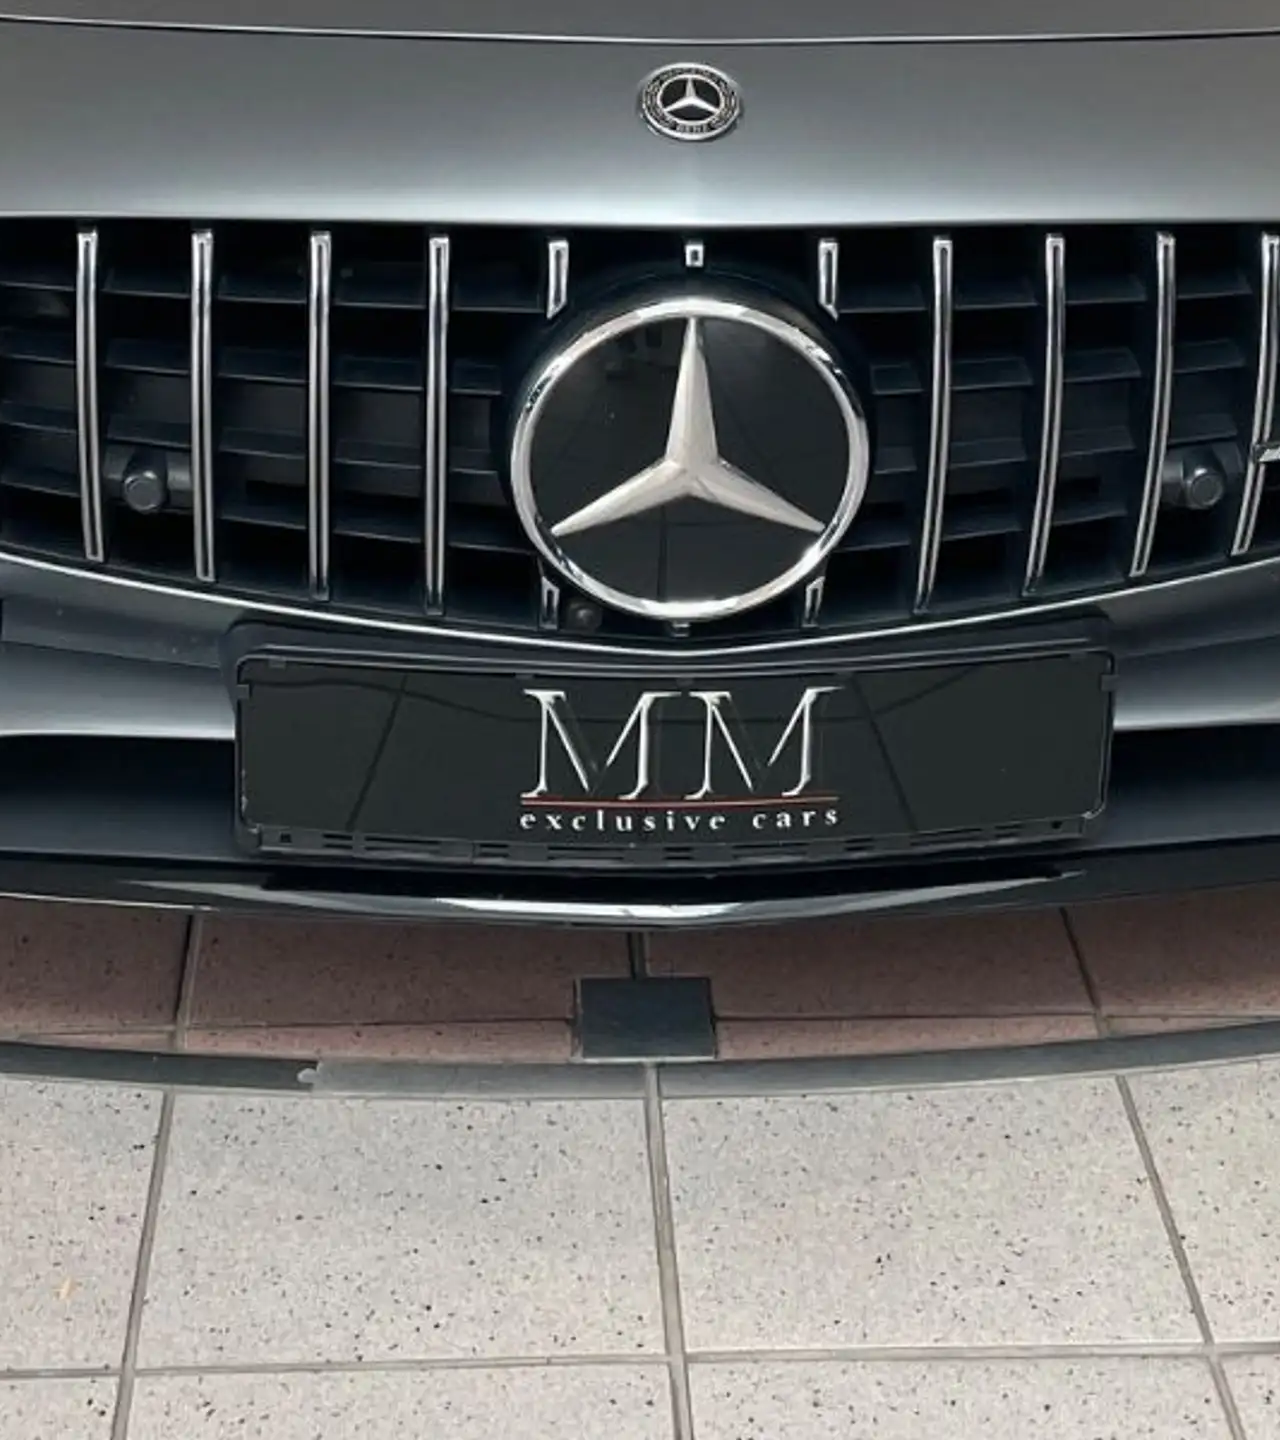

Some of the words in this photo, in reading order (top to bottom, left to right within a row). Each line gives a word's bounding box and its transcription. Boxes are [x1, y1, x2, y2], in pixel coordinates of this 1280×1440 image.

[520, 686, 845, 801] MM
[520, 809, 726, 832] exclusive
[752, 809, 839, 830] cars
